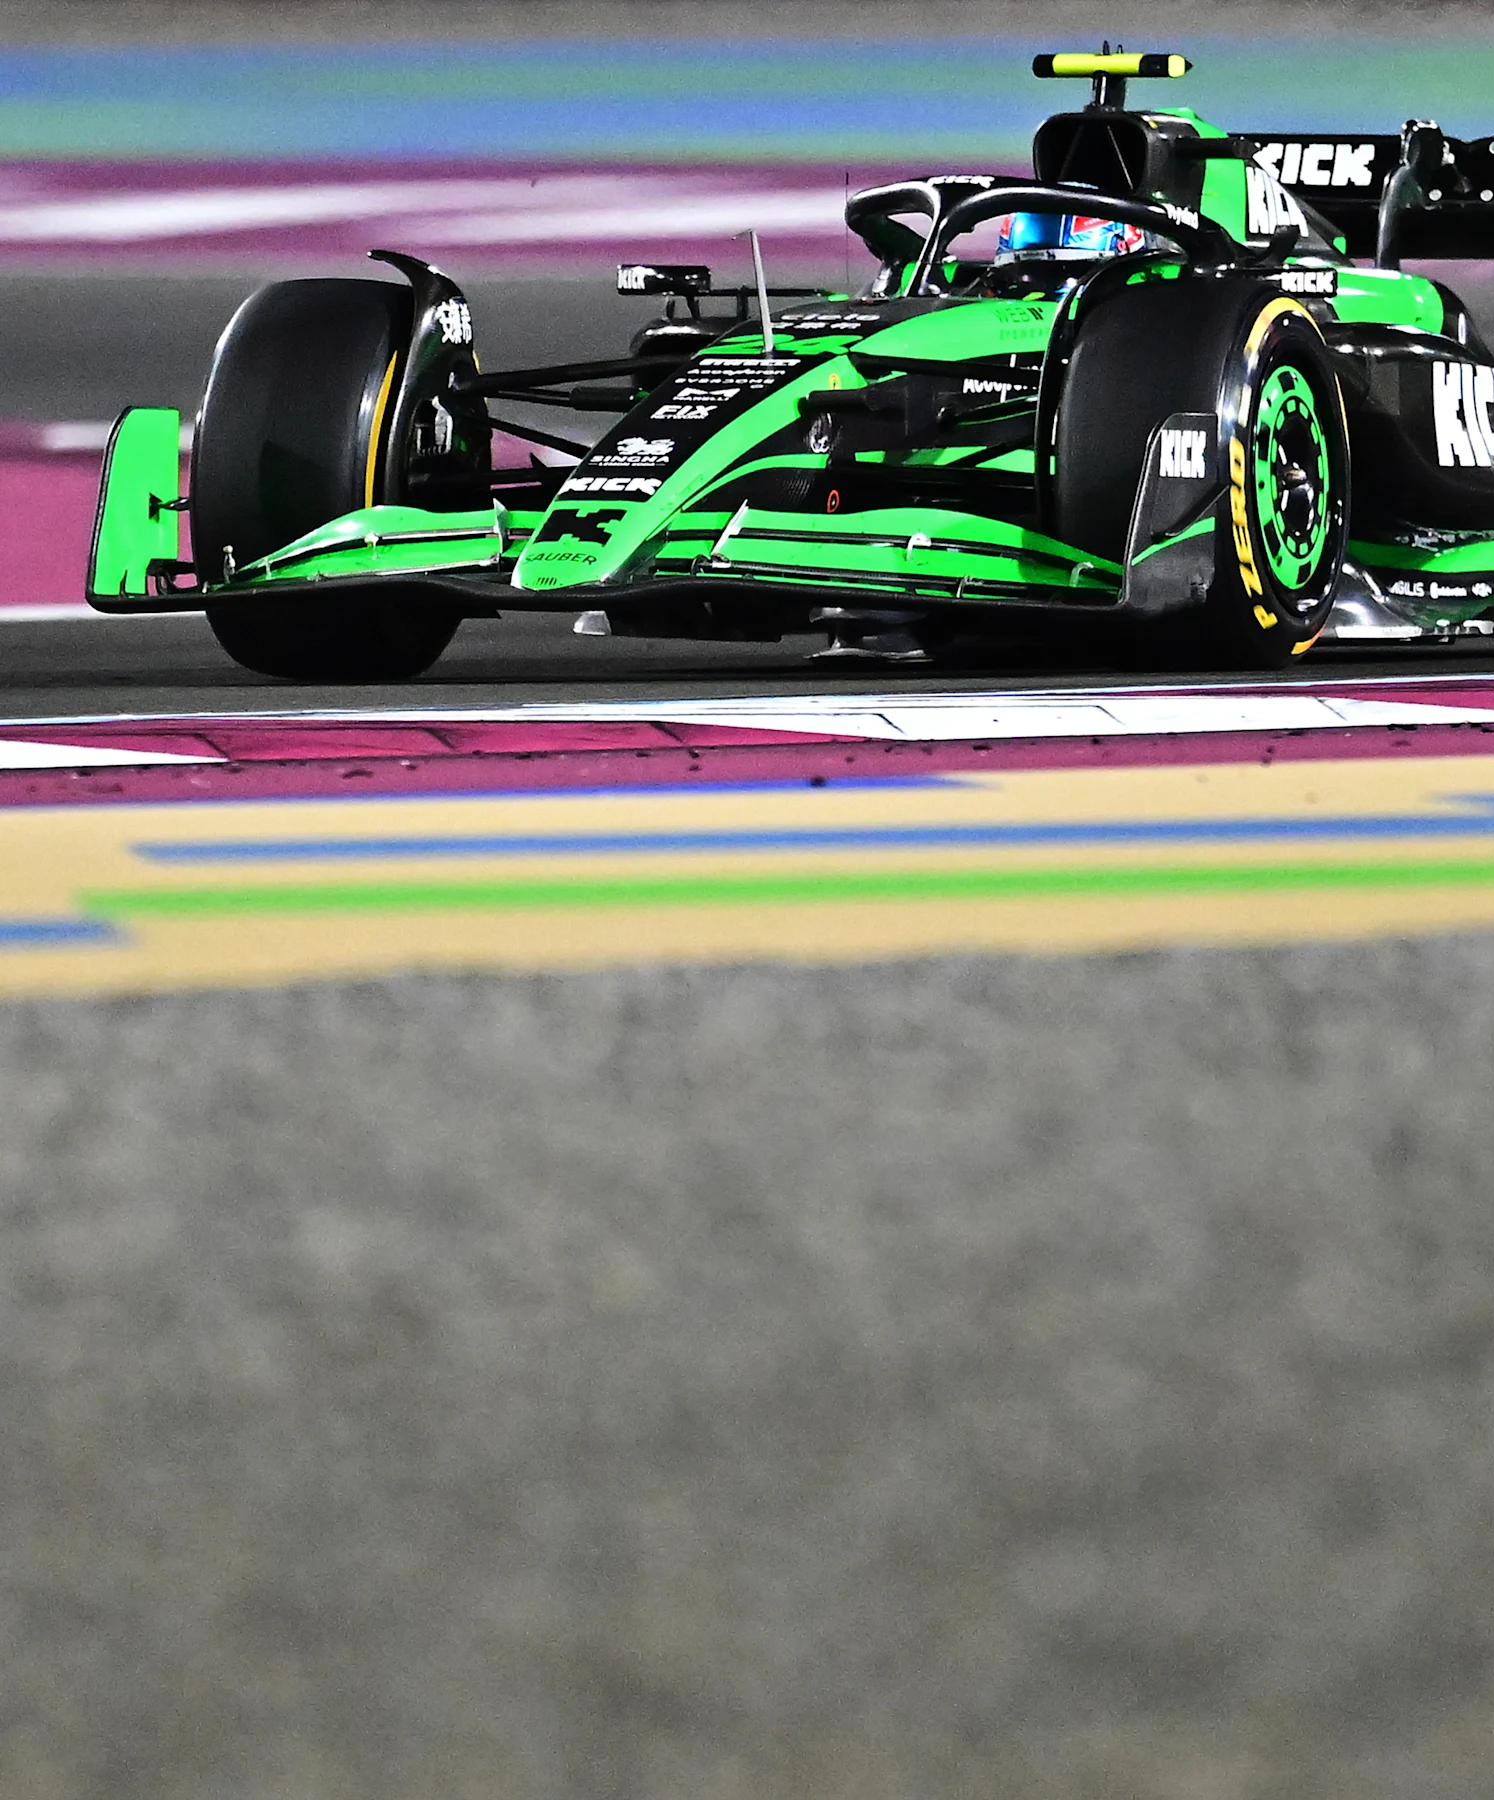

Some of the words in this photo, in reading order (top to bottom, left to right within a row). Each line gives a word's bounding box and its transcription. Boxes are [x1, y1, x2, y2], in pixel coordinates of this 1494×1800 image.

[1280, 271, 1334, 293] KICK
[697, 333, 864, 355] 24
[653, 404, 718, 416] FIX
[1159, 429, 1206, 479] KICK
[556, 477, 663, 496] KICK
